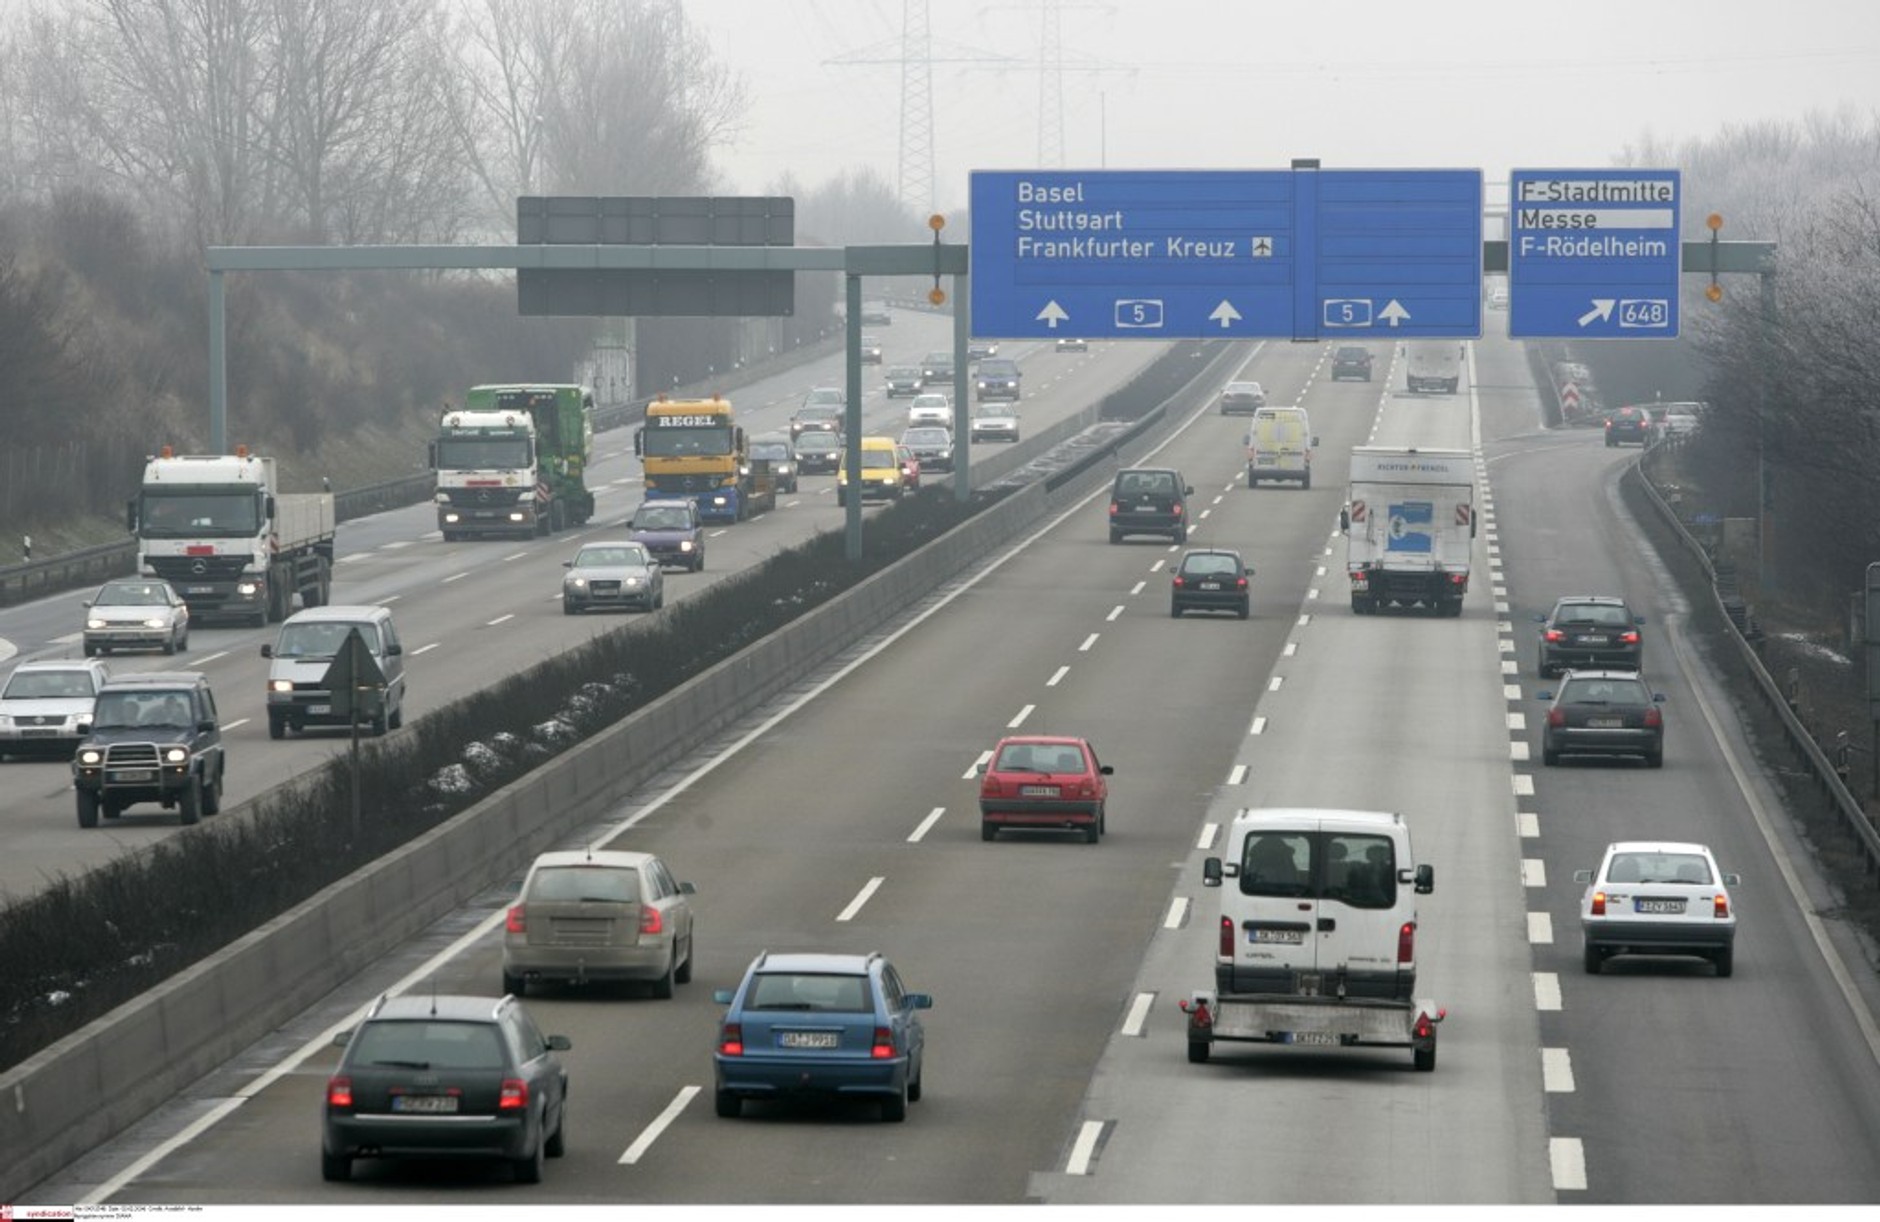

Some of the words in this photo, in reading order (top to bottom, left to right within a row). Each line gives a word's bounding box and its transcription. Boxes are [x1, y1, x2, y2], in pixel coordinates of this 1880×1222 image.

[1018, 182, 1084, 202] Basel
[1521, 181, 1671, 201] F-Stadtmitte
[1018, 210, 1122, 230] Stuttgart
[1521, 209, 1597, 229] Messe
[1018, 237, 1154, 257] Frankfurter
[1167, 237, 1235, 257] Kreuz
[1521, 236, 1667, 256] F-Rödelheim
[1134, 304, 1145, 322] 5
[1342, 304, 1353, 322] 5
[1626, 304, 1663, 322] 648
[659, 416, 716, 427] REGEL
